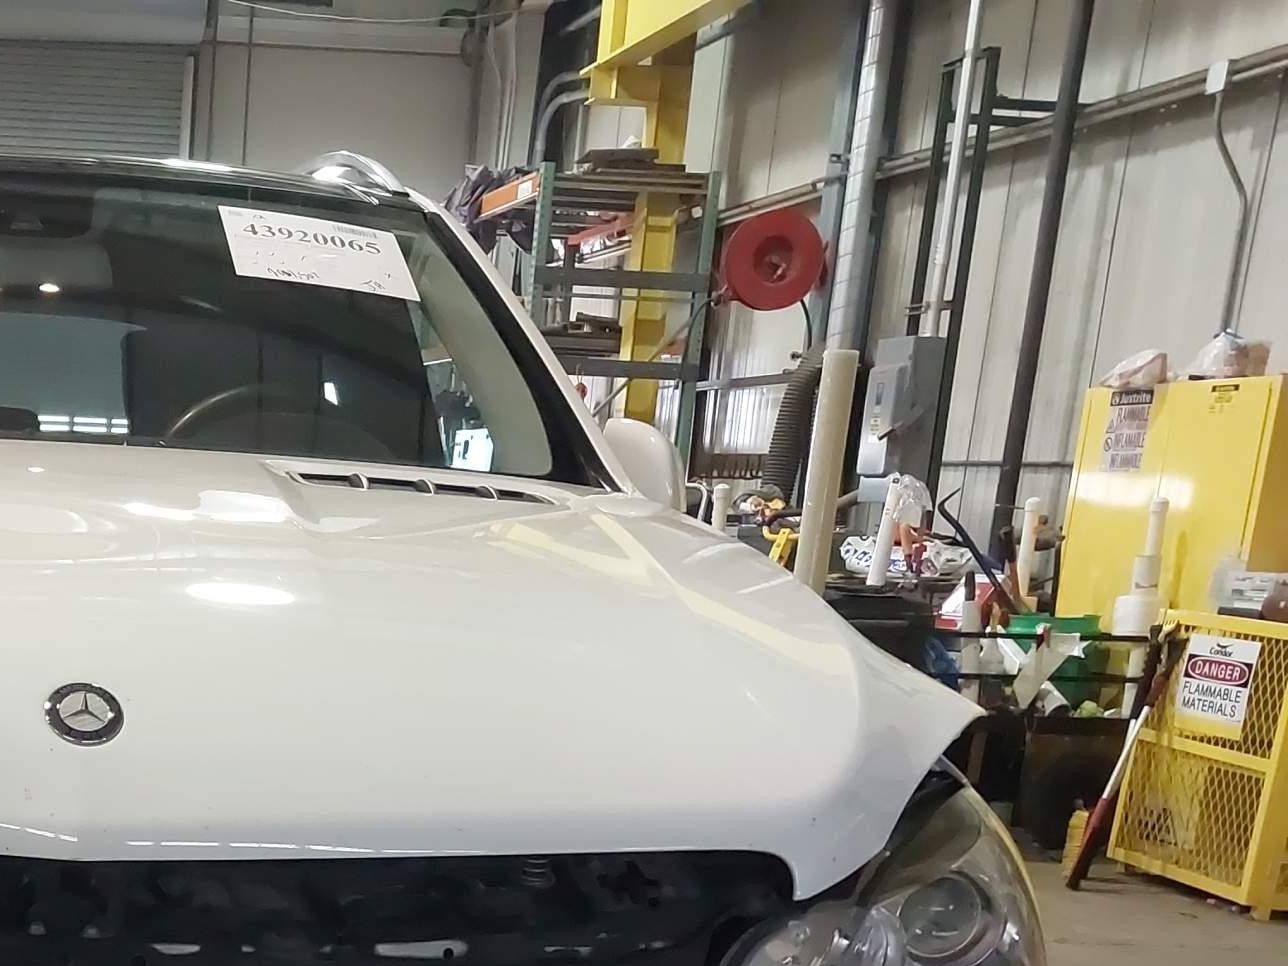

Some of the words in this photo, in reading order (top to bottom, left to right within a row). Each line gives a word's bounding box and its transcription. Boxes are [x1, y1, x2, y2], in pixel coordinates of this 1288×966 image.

[242, 222, 382, 255] 43920065
[1209, 646, 1234, 658] Condor
[1195, 660, 1241, 681] DANGER
[1182, 681, 1243, 704] FLAMMABLE
[1181, 696, 1237, 718] MATERIALS
